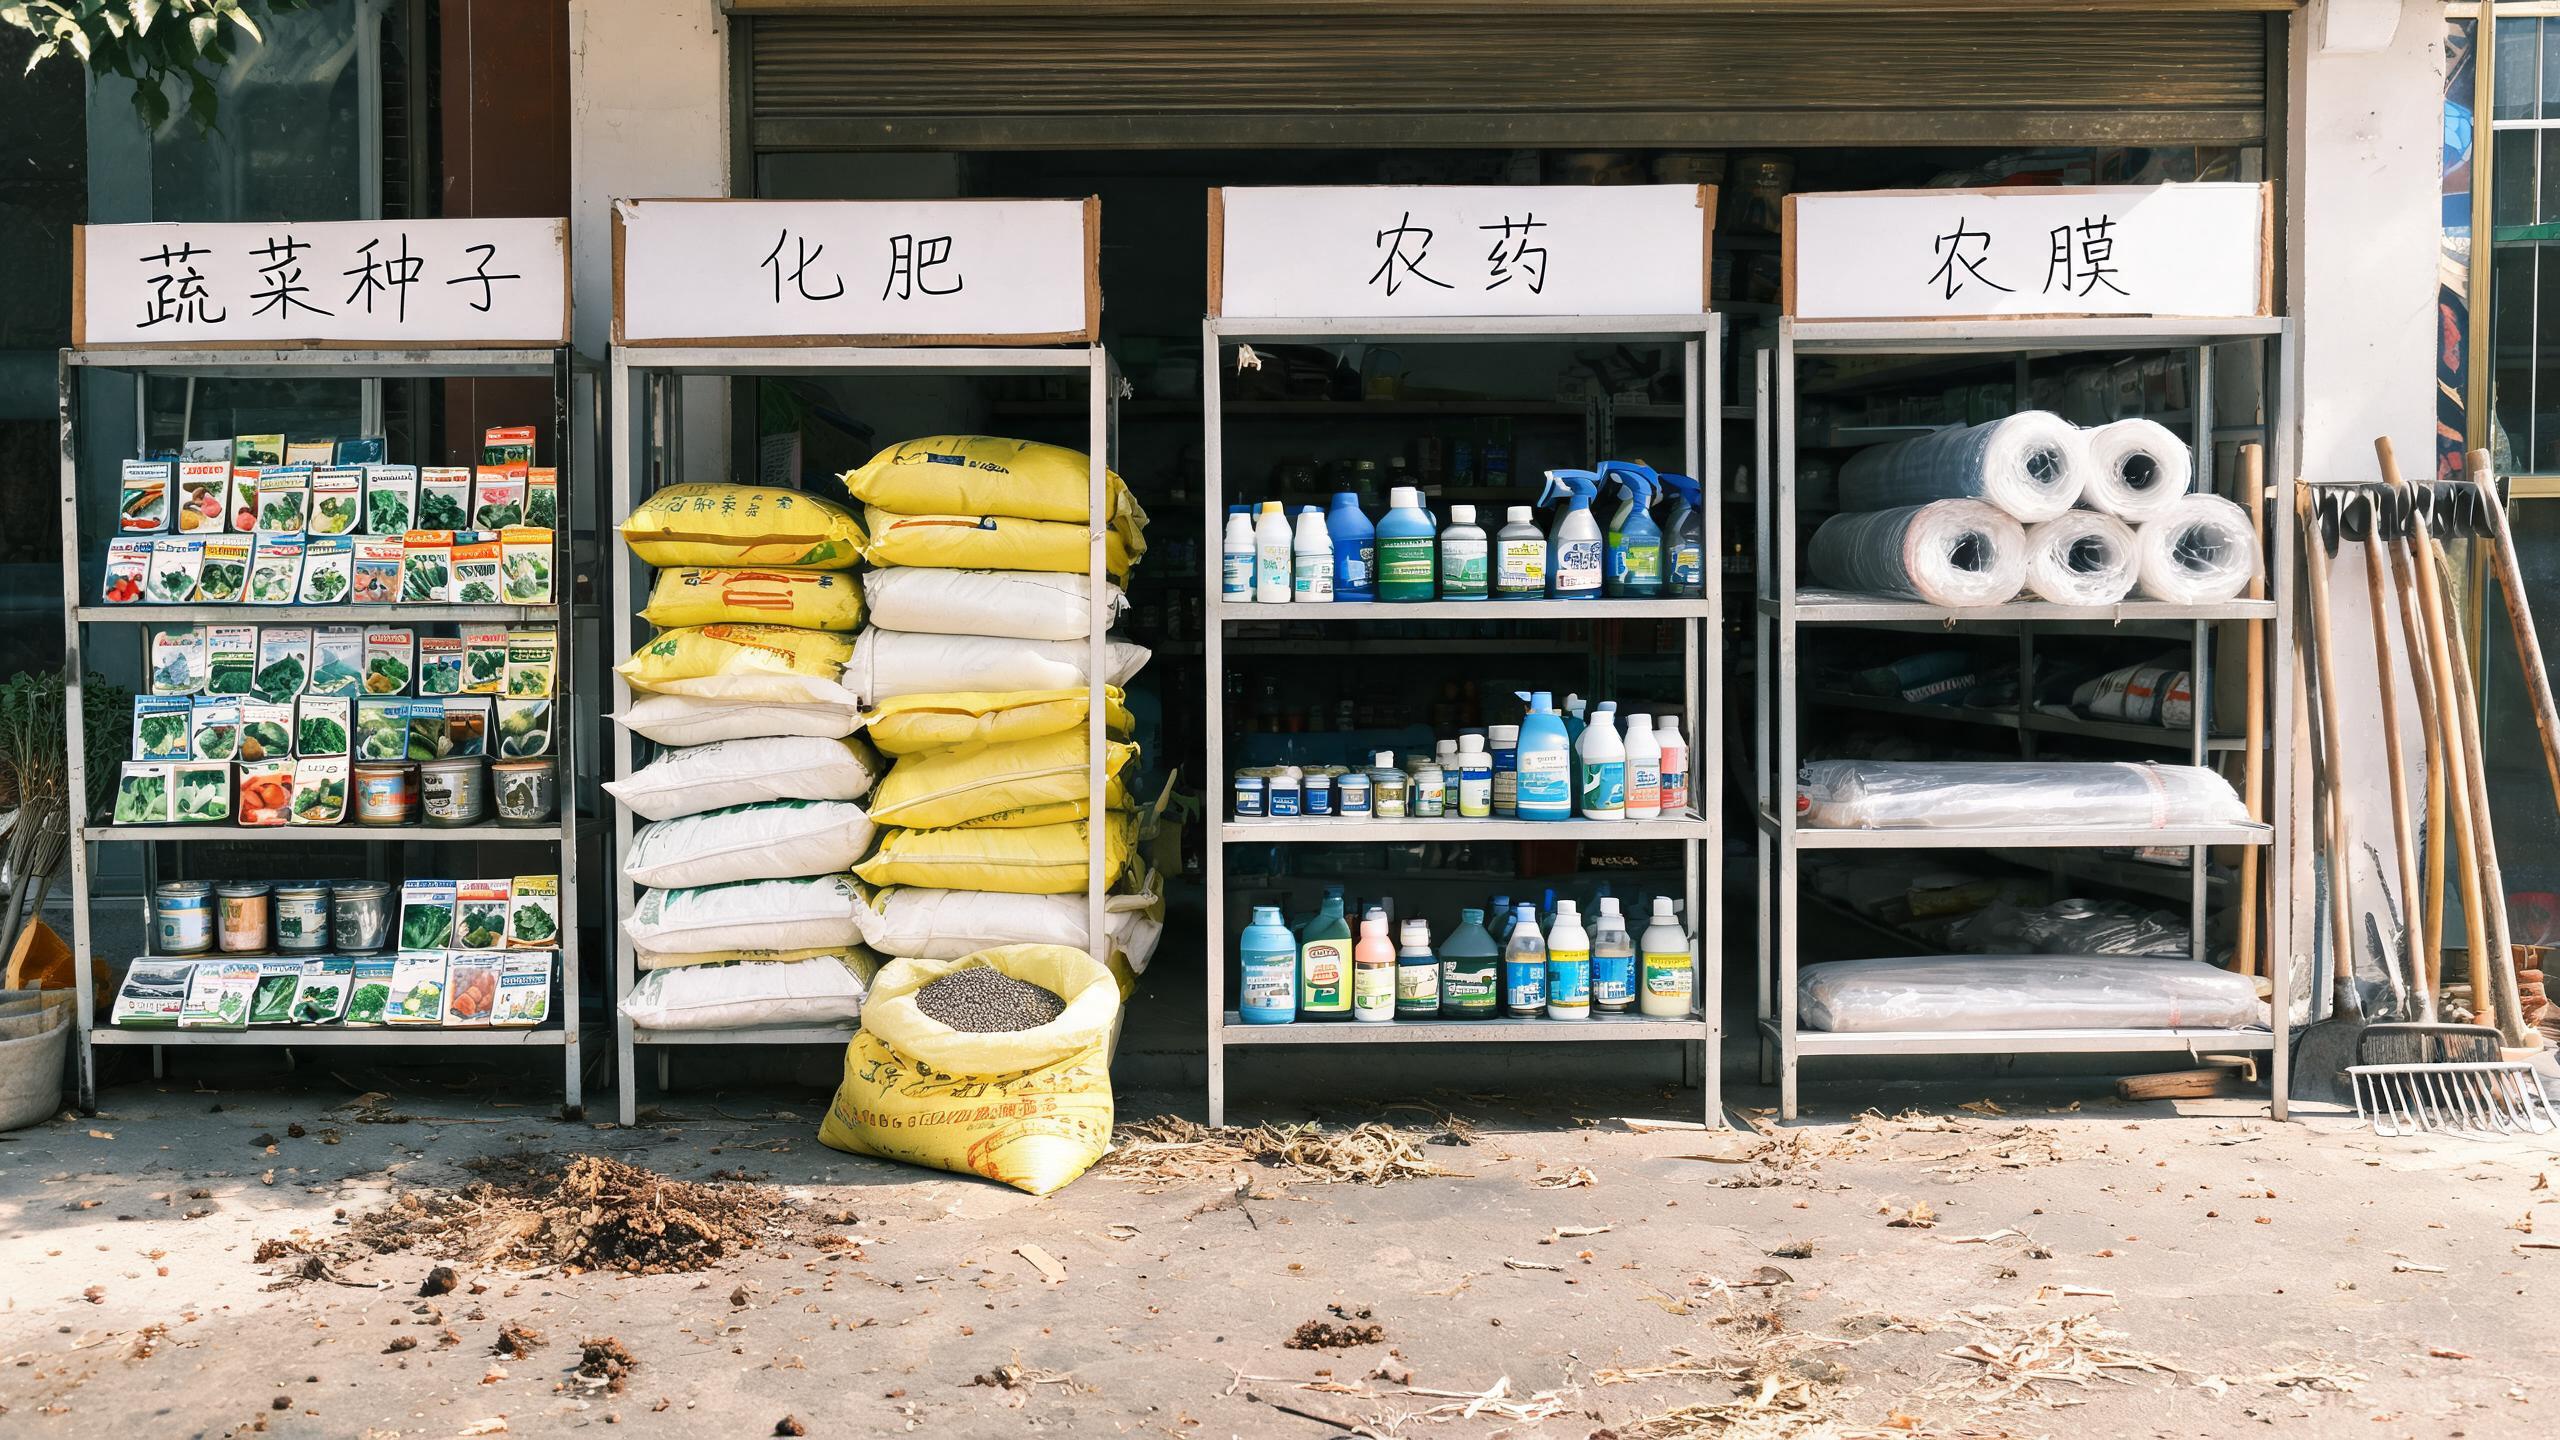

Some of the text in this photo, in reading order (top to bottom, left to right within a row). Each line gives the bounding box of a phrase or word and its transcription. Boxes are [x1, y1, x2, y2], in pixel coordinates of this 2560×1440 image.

[136, 231, 521, 329] 蔬菜种子
[760, 228, 963, 304] 化肥
[1368, 211, 1548, 297] 农药
[1927, 214, 2130, 301] 农膜
